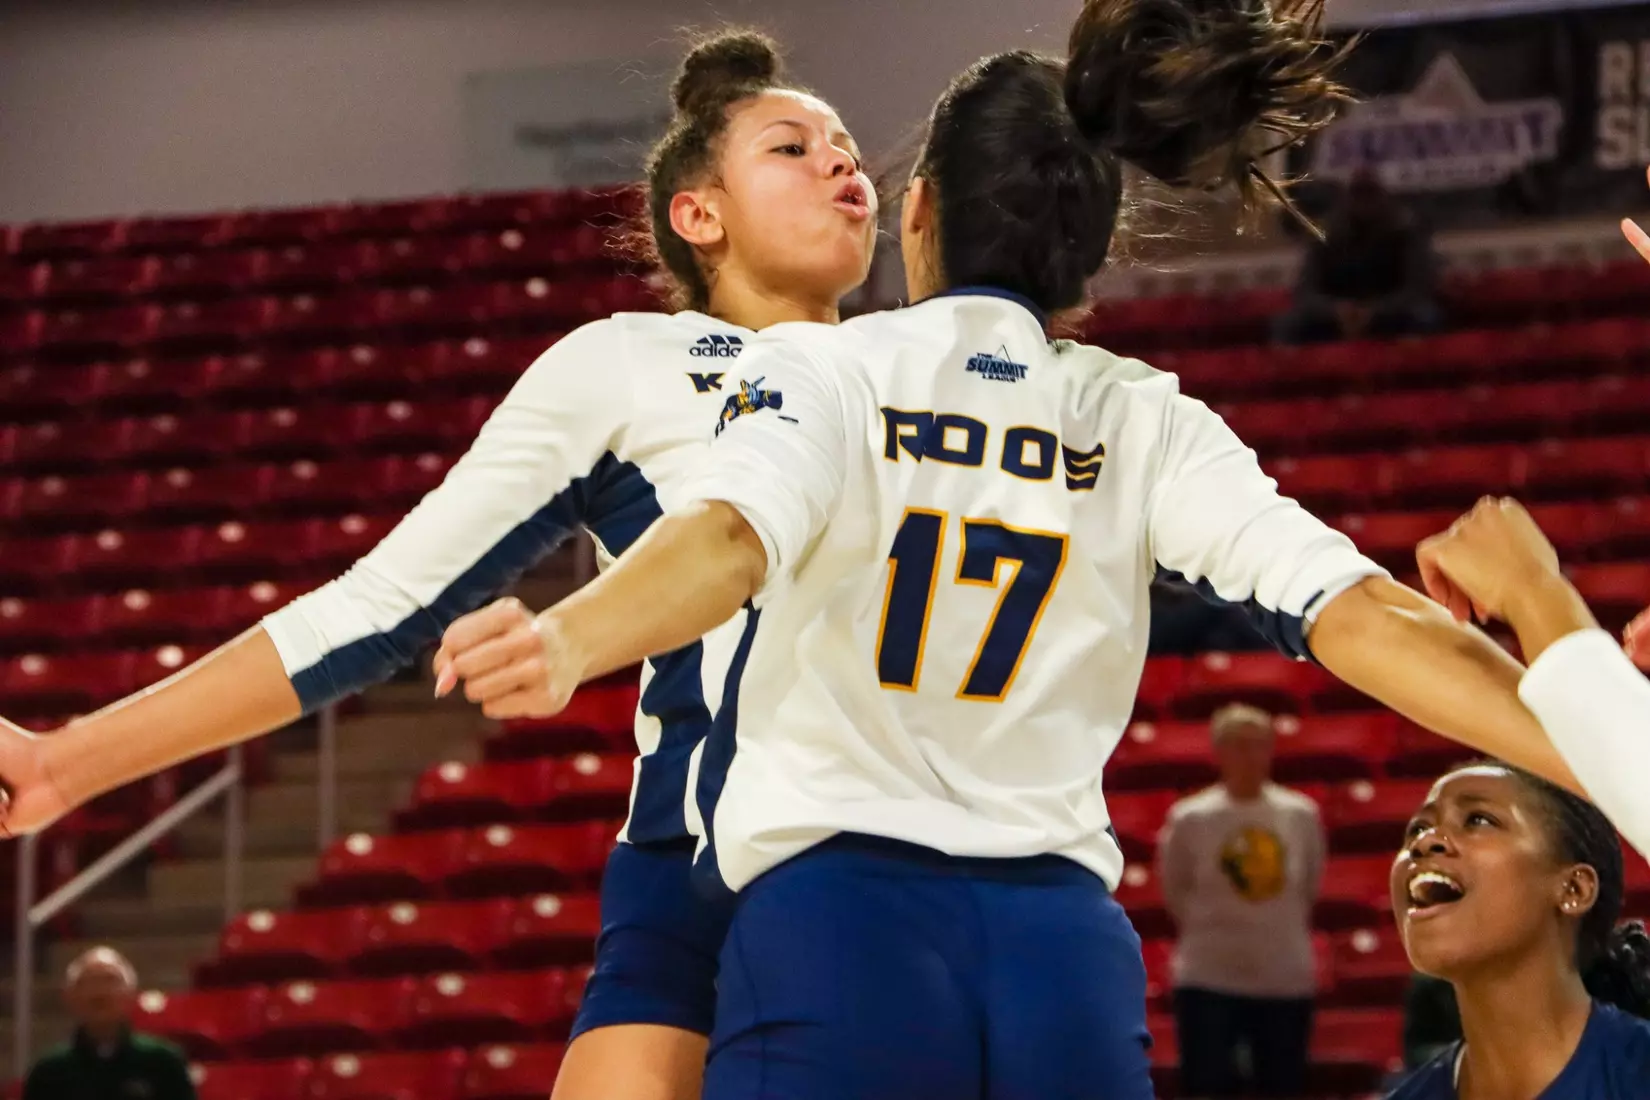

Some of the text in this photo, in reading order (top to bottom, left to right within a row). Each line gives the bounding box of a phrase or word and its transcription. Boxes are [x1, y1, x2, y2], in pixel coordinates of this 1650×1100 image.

[689, 343, 742, 358] adida
[965, 357, 1029, 379] SUMMIT
[880, 406, 1106, 492] ROOS
[875, 505, 1070, 704] 17
